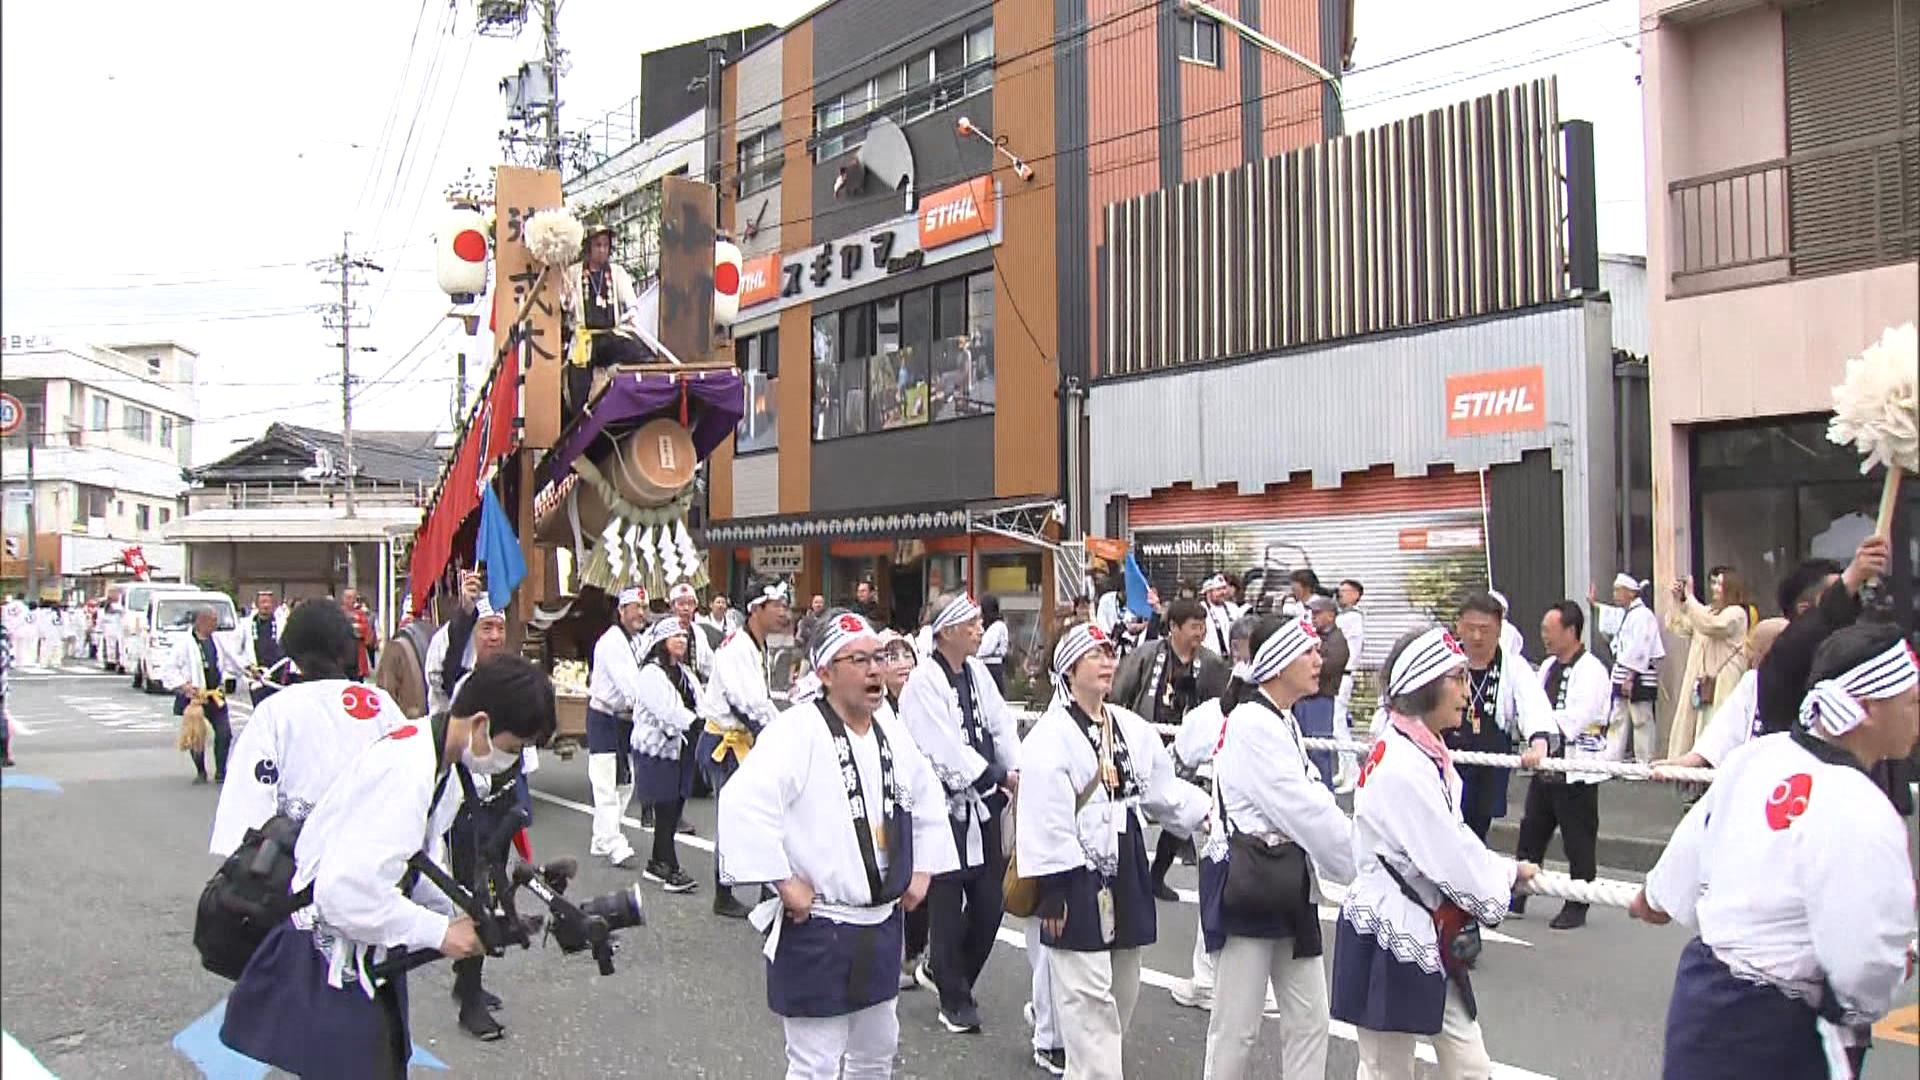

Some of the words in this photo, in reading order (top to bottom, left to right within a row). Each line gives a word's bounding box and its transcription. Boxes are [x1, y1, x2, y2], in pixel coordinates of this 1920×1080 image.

[924, 193, 977, 232] STIHL
[782, 231, 896, 298] スギヤマ
[1450, 386, 1535, 420] STIHL
[1142, 539, 1236, 555] www.stihl.co.jp
